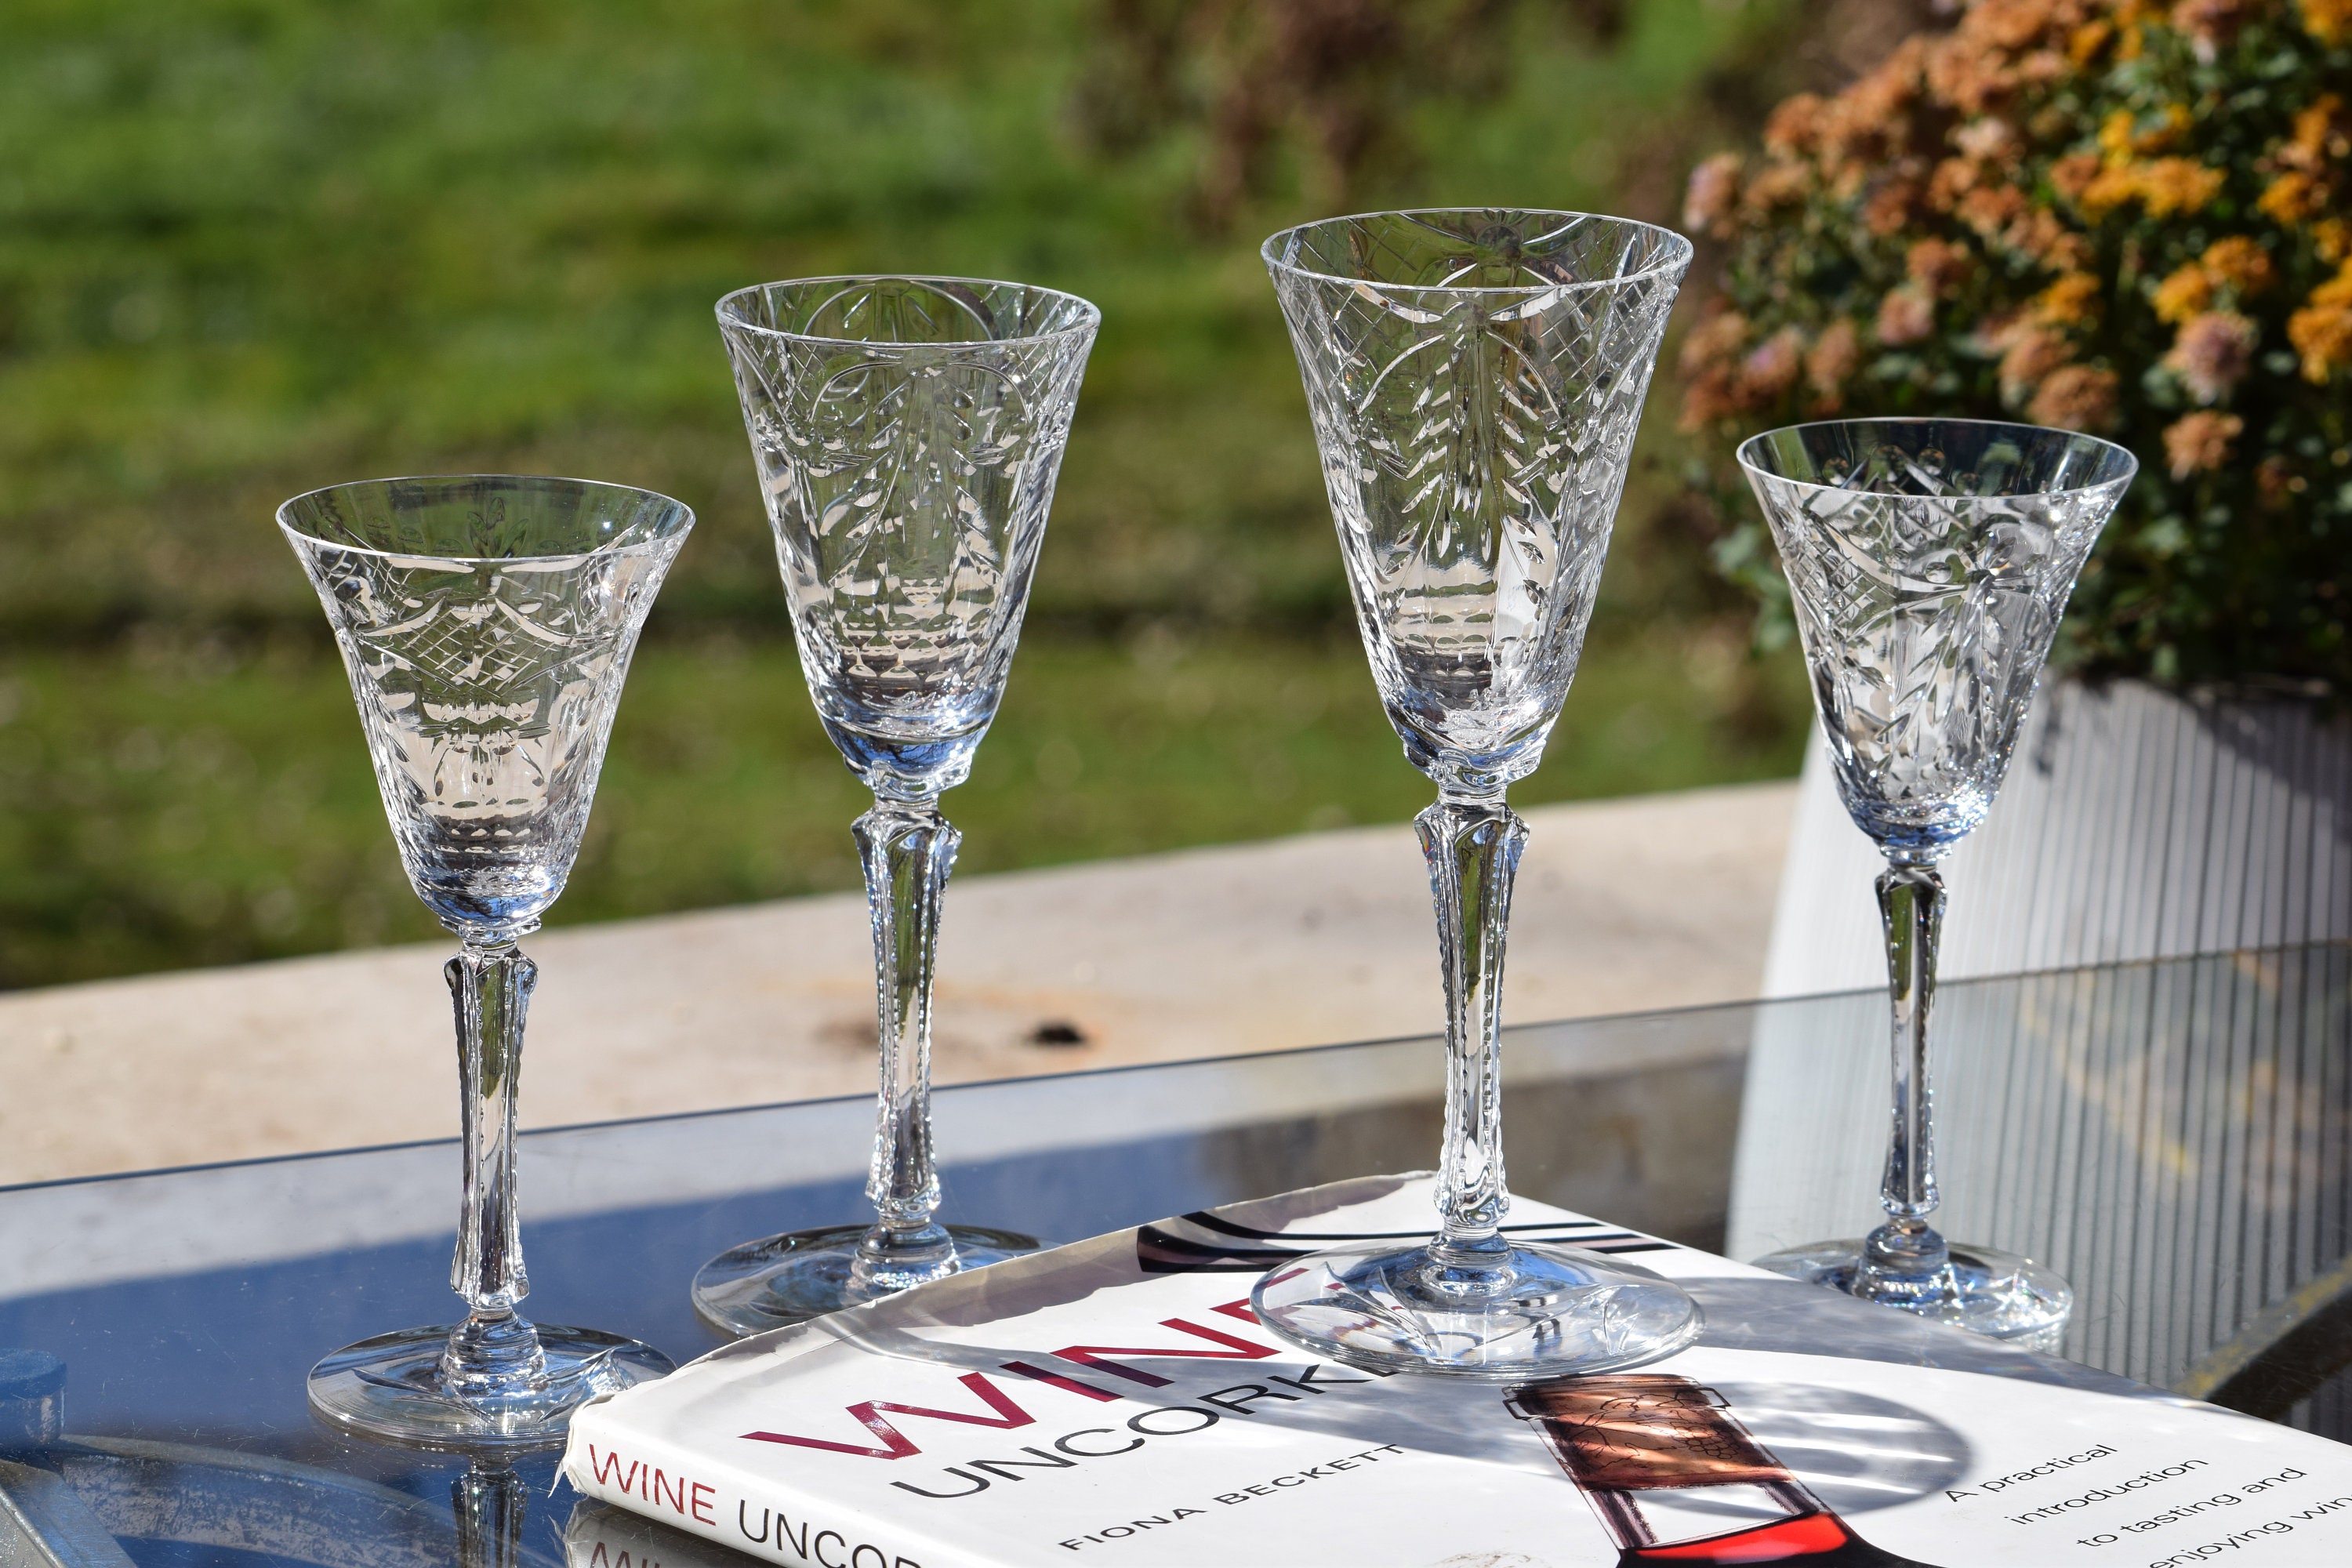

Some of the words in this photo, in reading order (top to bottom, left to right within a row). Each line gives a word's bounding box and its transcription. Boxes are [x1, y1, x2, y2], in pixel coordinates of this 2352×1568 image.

[890, 1363, 1400, 1498] UNCORK
[589, 1443, 717, 1526] WINE
[1058, 1507, 1208, 1552] FIONA
[1213, 1443, 1404, 1504] BECKETT
[1944, 1490, 1980, 1503] A
[1980, 1444, 2118, 1493] practical
[2004, 1460, 2209, 1526] introduction
[2077, 1534, 2118, 1548] to
[2120, 1494, 2242, 1534] tasting
[2241, 1468, 2308, 1494] and
[2149, 1521, 2294, 1568] enjoying
[2289, 1494, 2352, 1519] win
